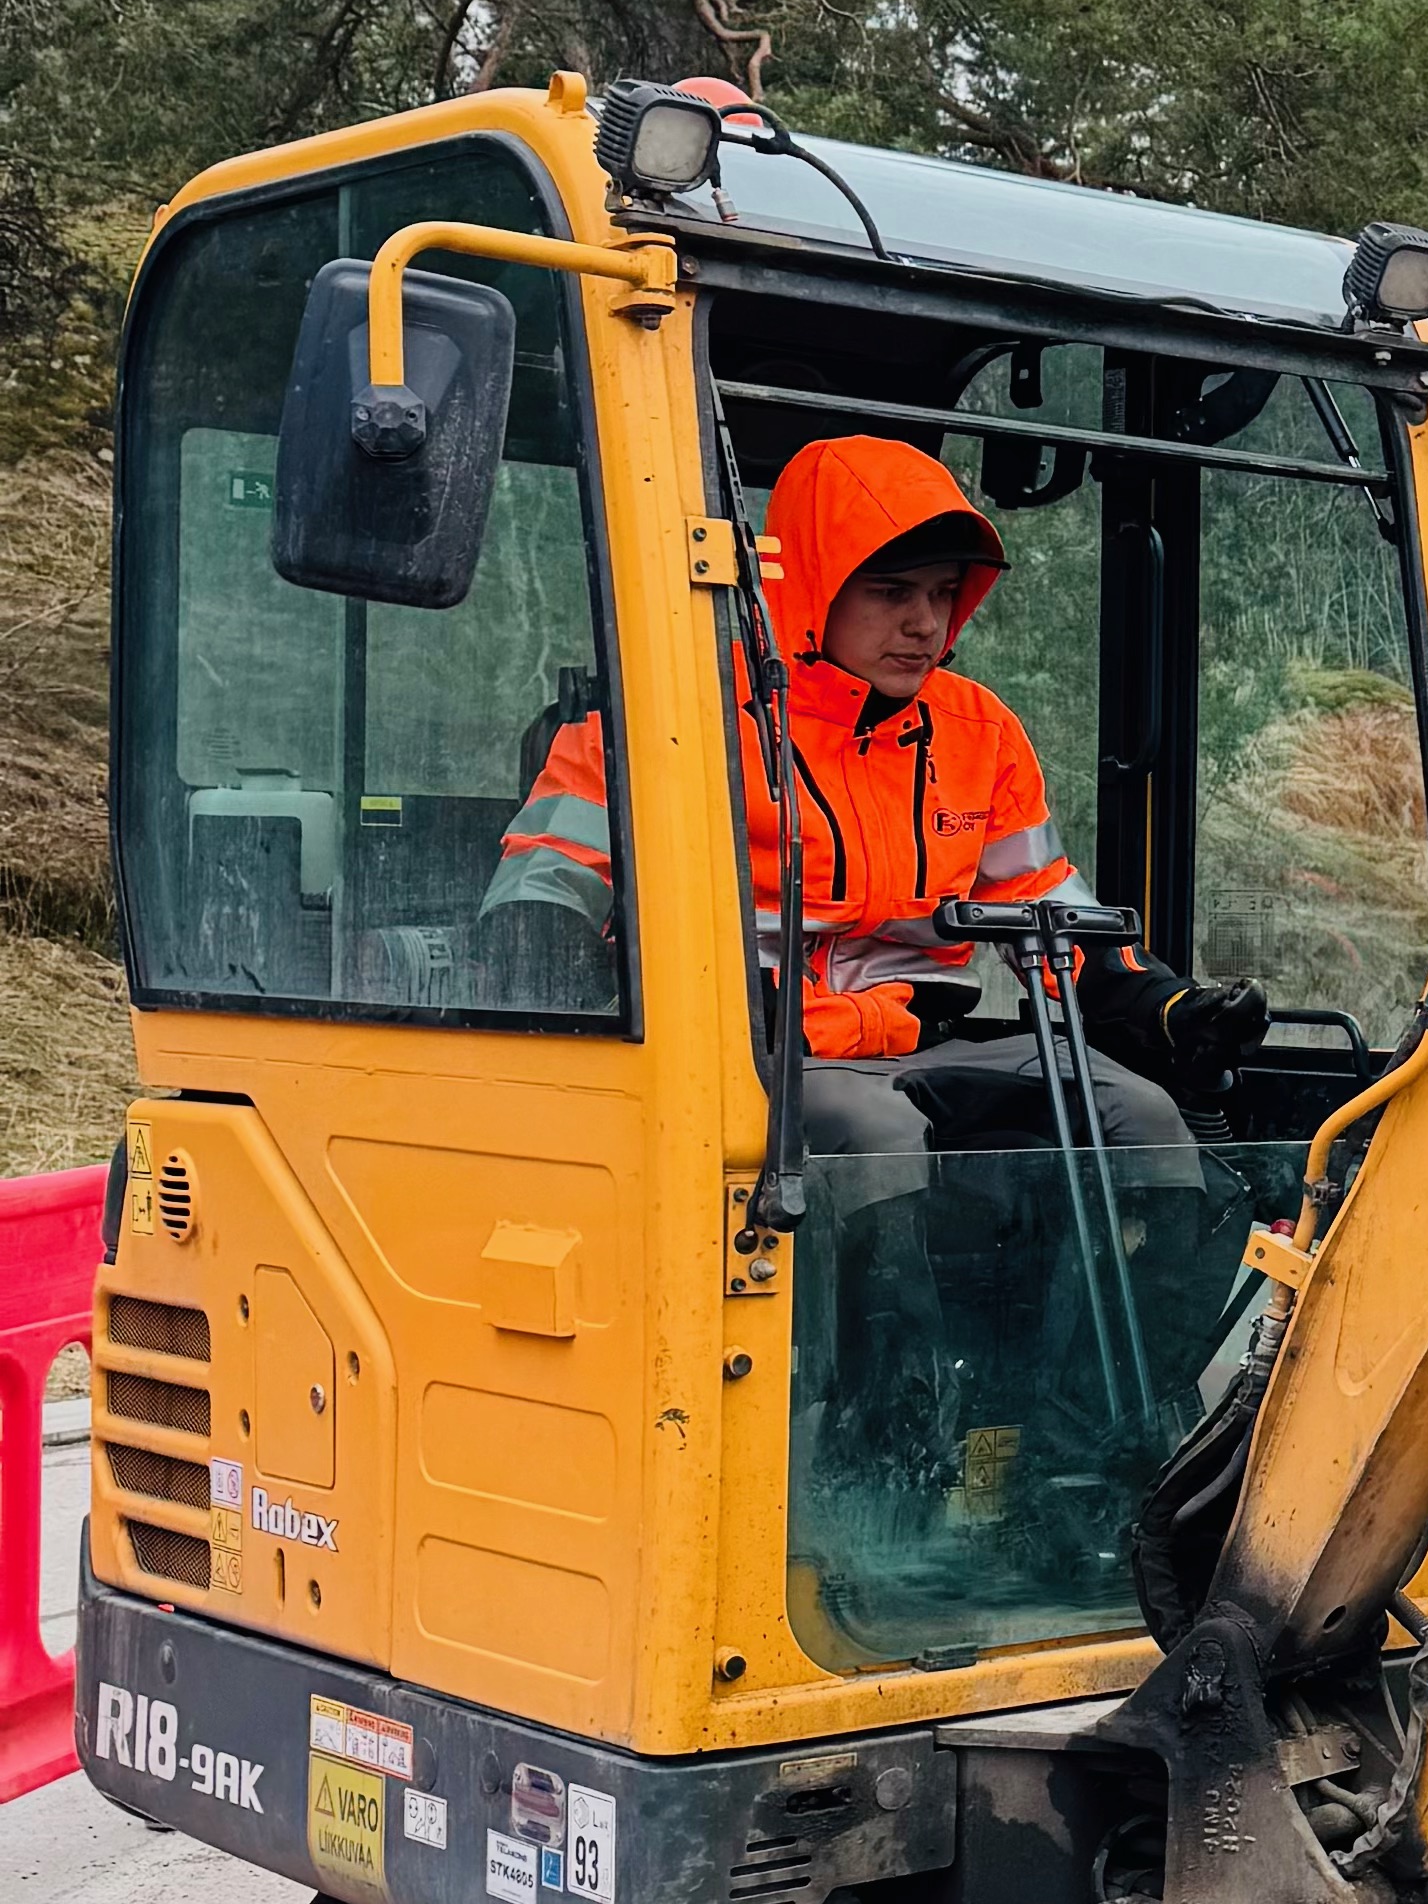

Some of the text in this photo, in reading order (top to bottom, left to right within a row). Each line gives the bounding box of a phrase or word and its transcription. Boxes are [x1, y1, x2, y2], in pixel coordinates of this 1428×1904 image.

[252, 1486, 339, 1552] Robex
[96, 1682, 264, 1814] R18-9AK
[338, 1787, 379, 1832] VARO
[575, 1835, 599, 1891] 93
